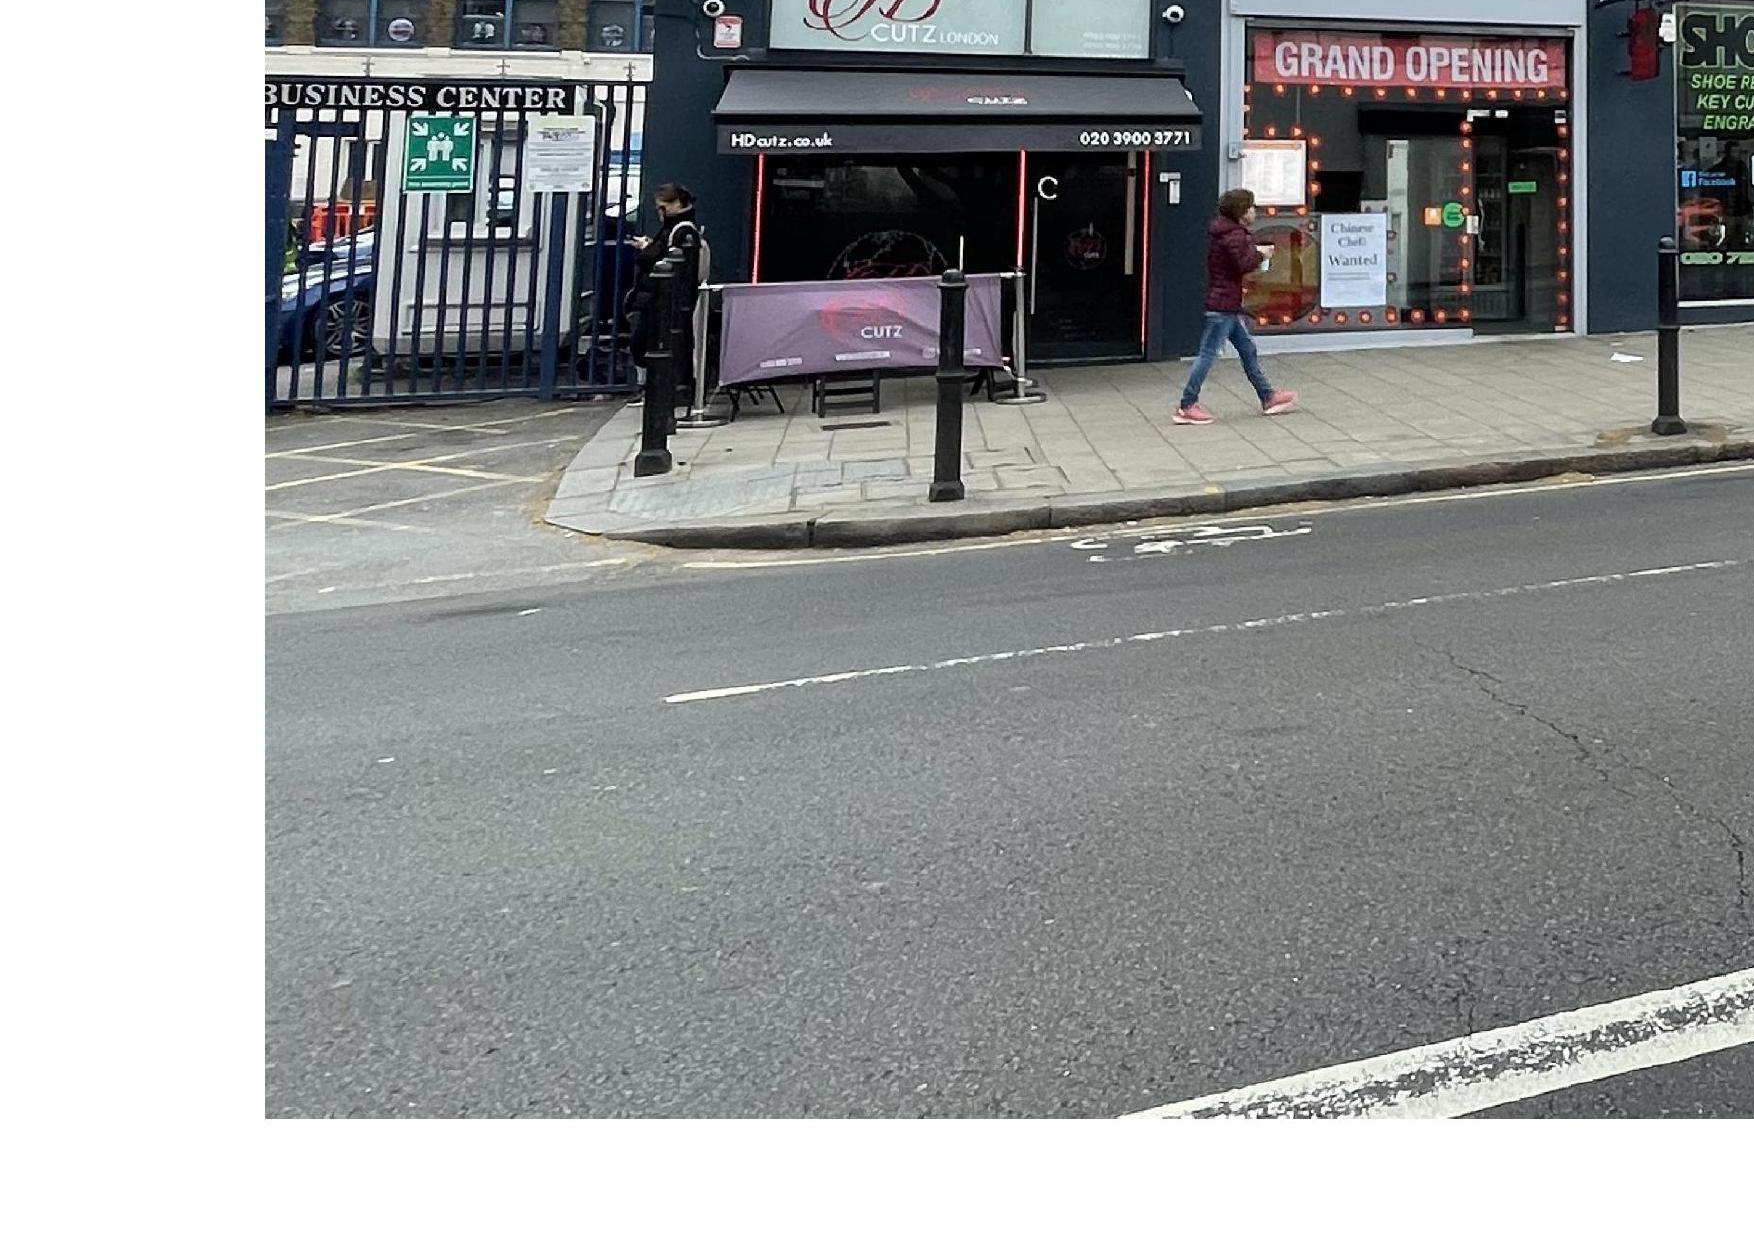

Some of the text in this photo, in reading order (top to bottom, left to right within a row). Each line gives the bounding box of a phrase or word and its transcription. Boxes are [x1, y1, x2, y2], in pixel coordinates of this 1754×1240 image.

[870, 22, 999, 46] CUTZ LONDON
[1275, 41, 1549, 83] GRAND OPENING
[1691, 73, 1737, 90] SHOE
[265, 83, 567, 108] BUSINESS CENTER
[1696, 94, 1731, 109] KEY
[731, 131, 834, 148] HDcutz.co.uk
[1079, 131, 1191, 146] 020 3900 3771
[1330, 222, 1375, 235] Chinese
[1328, 253, 1378, 267] Wanted
[861, 324, 903, 340] CUTZ
